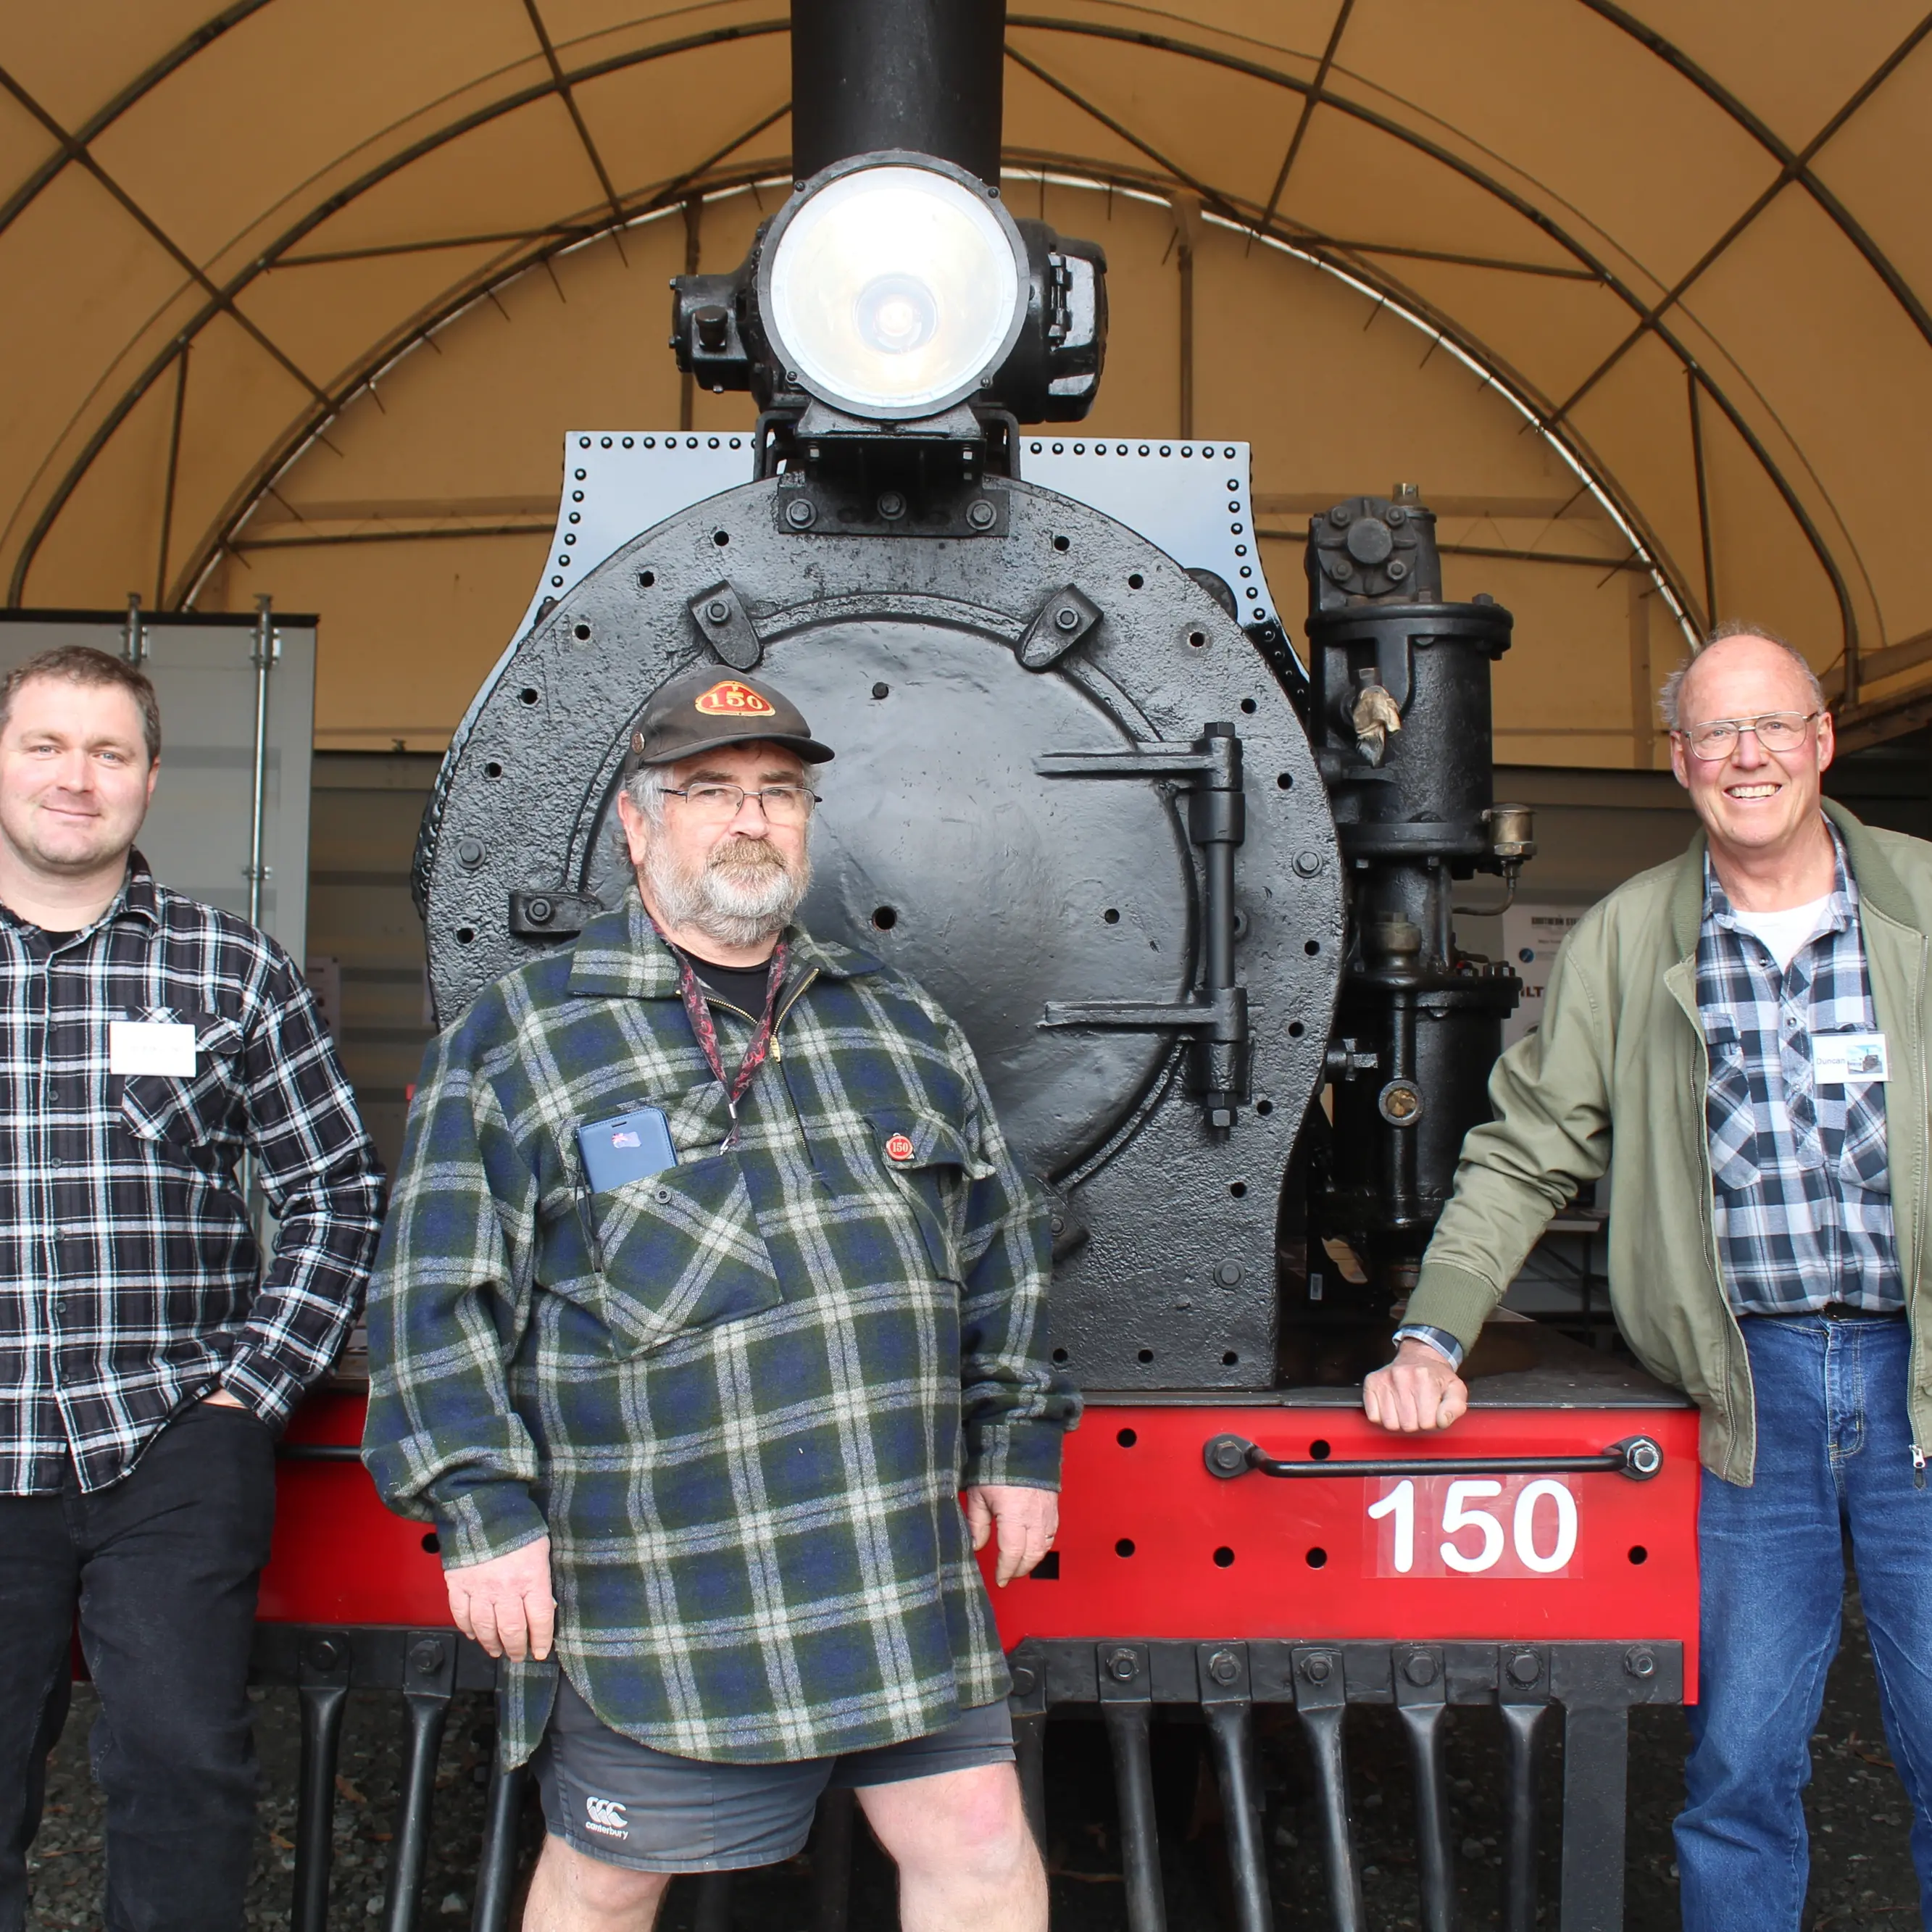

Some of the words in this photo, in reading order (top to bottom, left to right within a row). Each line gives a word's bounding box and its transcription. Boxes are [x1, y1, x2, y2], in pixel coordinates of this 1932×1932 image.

[709, 691, 763, 709] 150
[892, 1141, 909, 1153] 150
[1367, 1479, 1578, 1573] 150
[585, 1821, 629, 1841] canterbury
